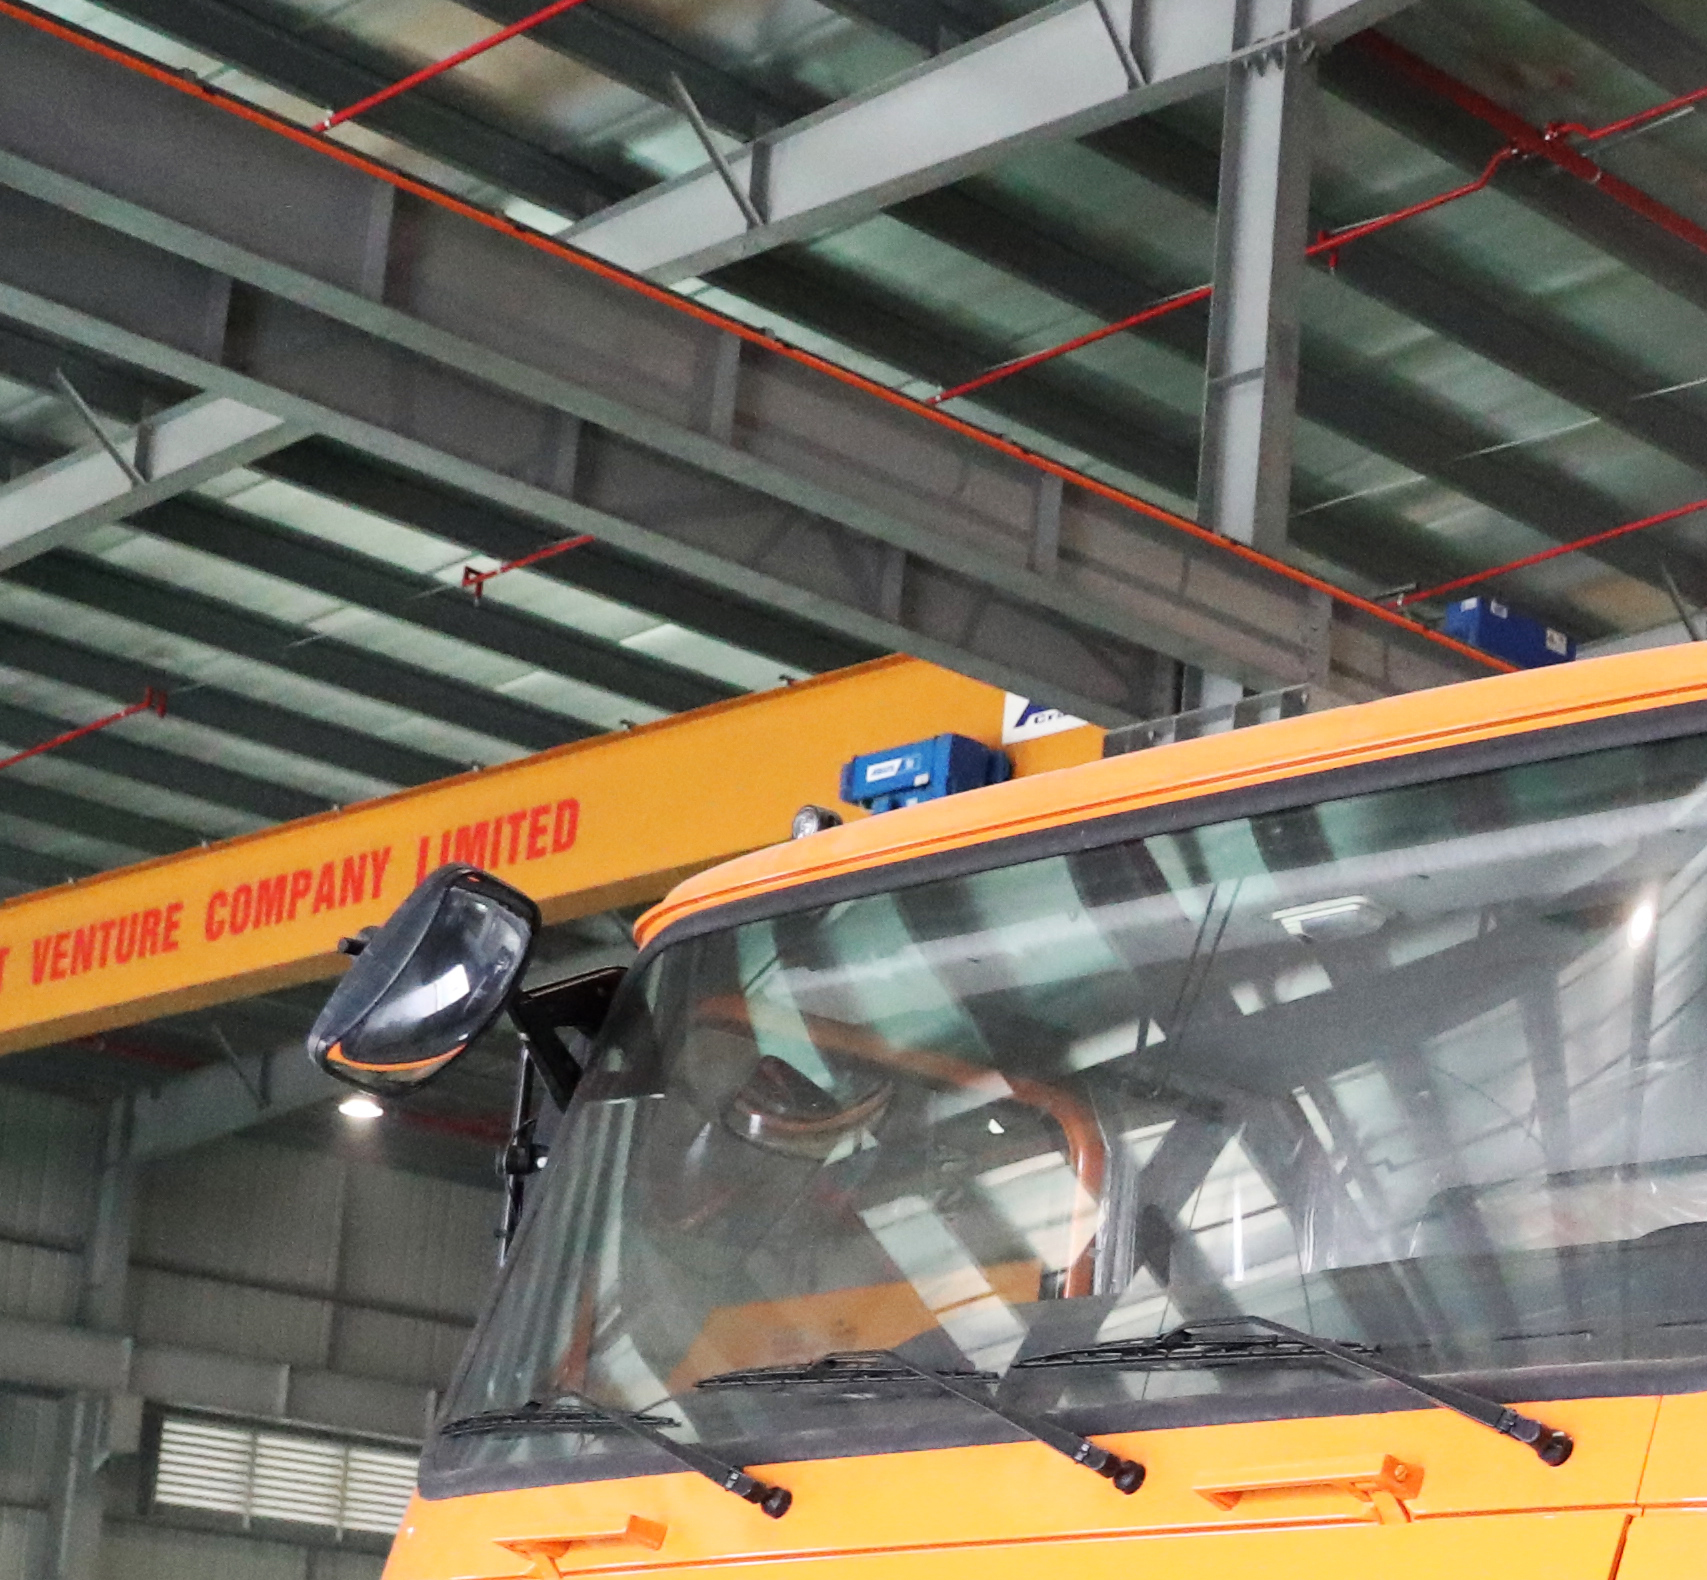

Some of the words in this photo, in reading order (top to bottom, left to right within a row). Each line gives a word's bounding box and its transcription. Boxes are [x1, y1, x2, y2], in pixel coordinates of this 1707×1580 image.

[31, 902, 185, 986] VENTURE
[205, 846, 391, 942] COMPANY
[416, 797, 580, 888] LIMITED
